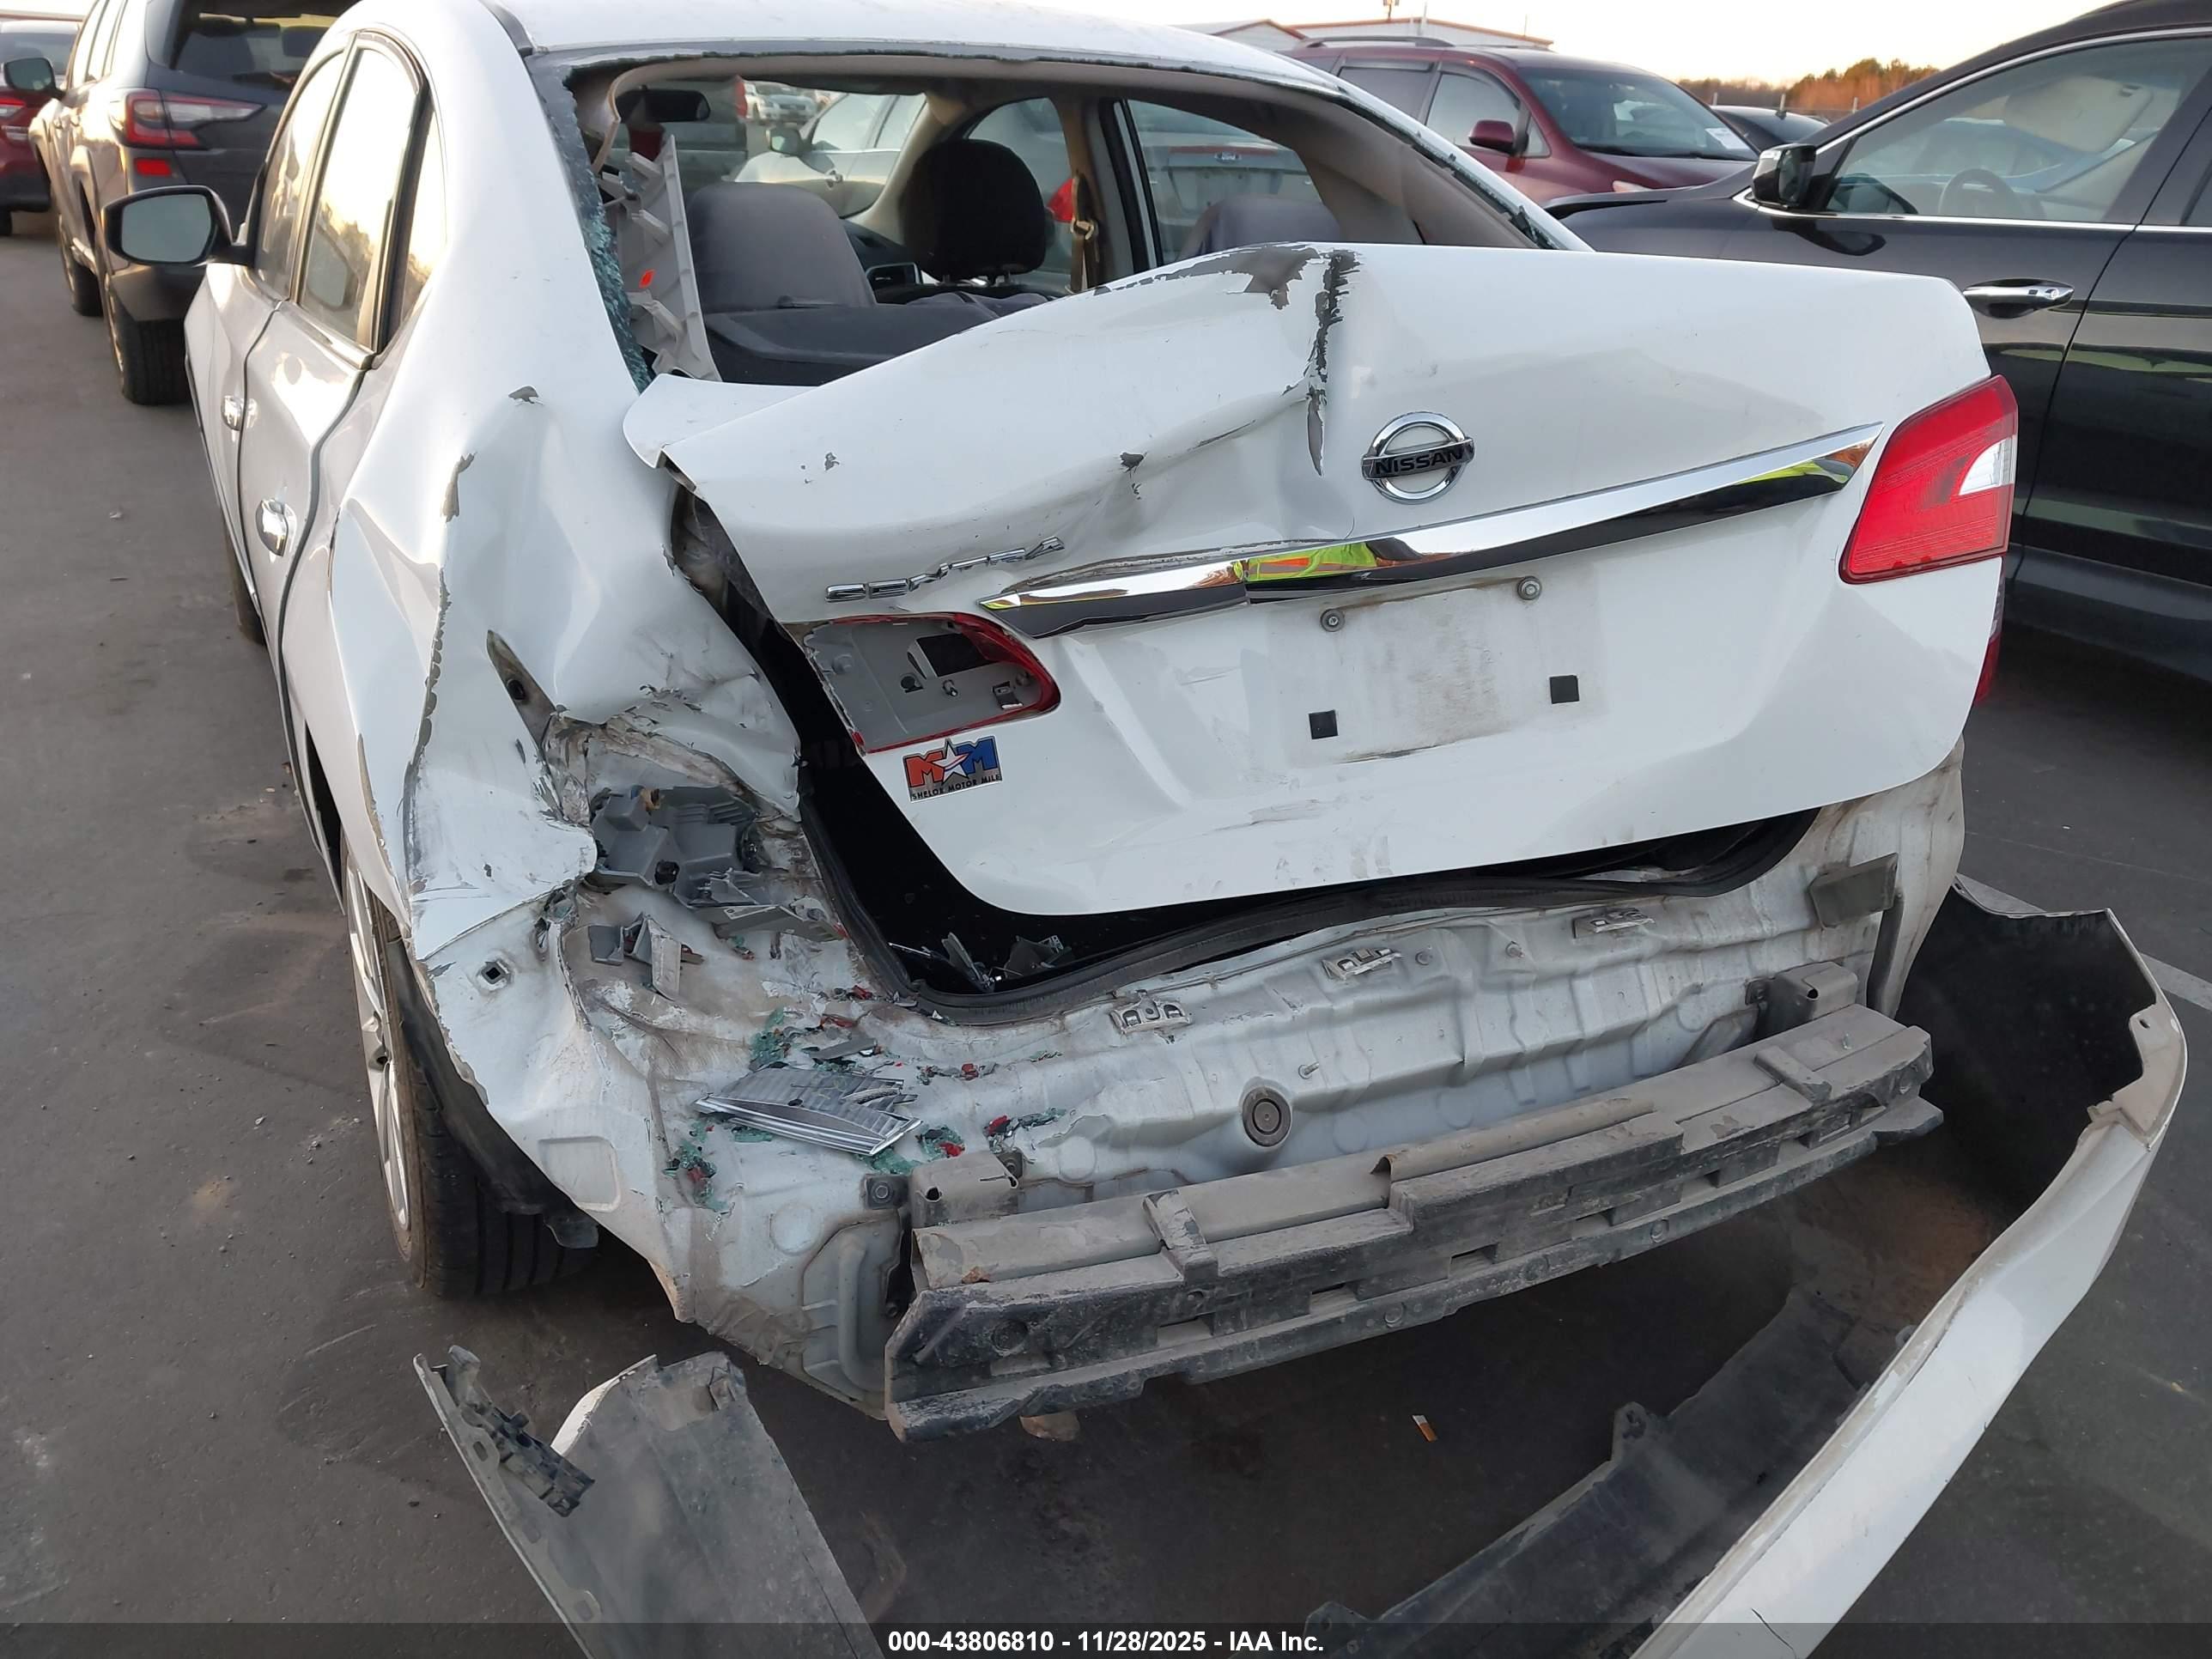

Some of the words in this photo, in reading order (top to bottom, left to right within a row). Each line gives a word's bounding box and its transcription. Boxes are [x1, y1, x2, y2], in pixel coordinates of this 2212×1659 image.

[1376, 450, 1463, 475] NISSAN
[948, 779, 977, 793] MOTOR
[981, 774, 1001, 785] MILE
